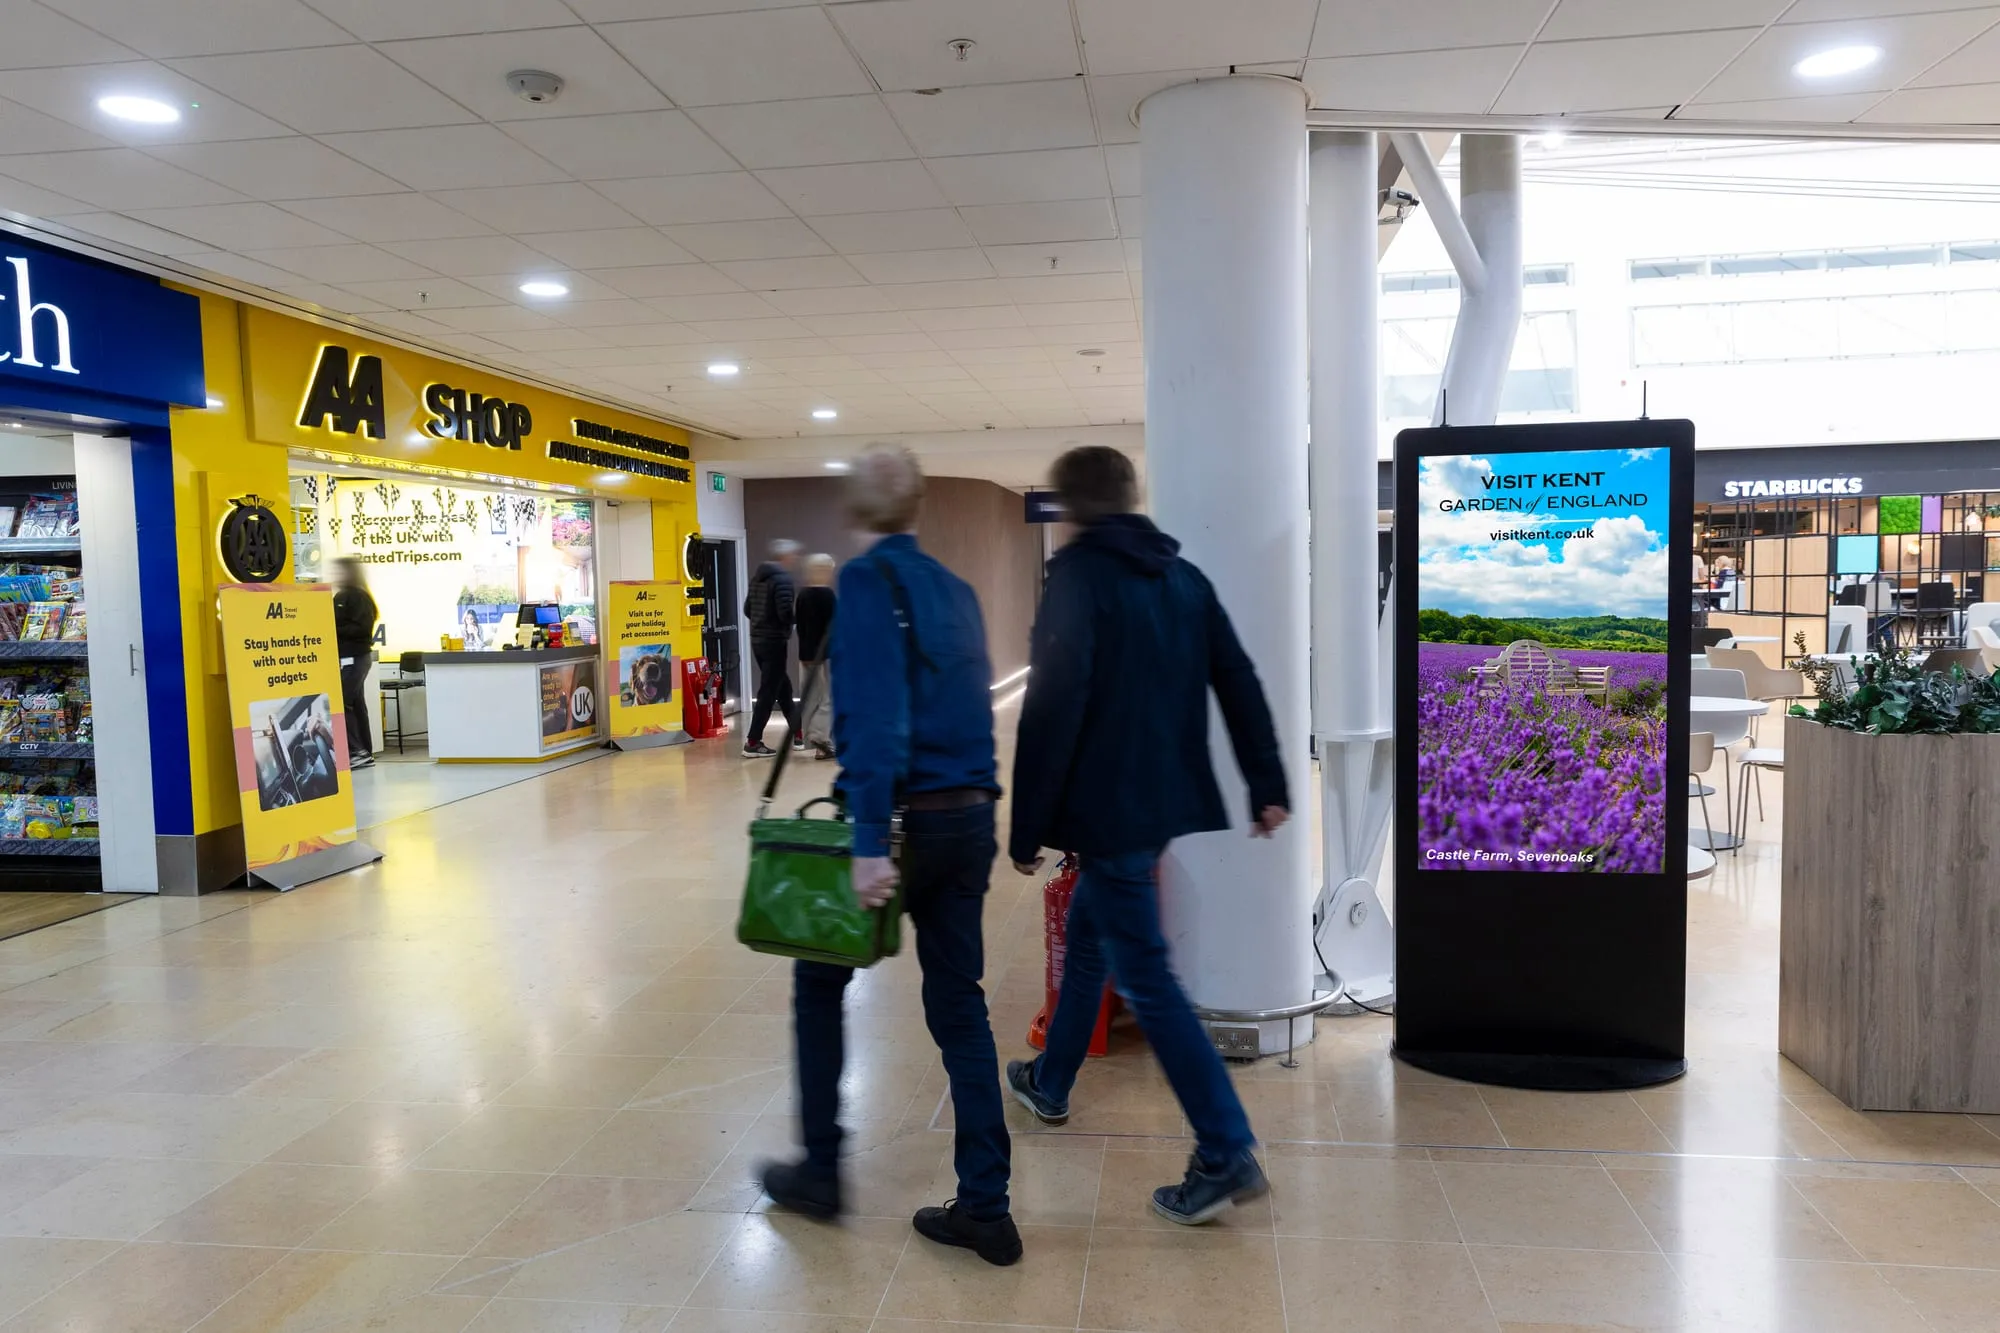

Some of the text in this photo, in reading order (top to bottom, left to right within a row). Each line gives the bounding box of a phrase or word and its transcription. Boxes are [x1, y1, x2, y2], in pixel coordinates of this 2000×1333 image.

[296, 344, 386, 440] AA
[422, 383, 533, 451] SHOP
[52, 481, 77, 490] LIVIN
[1481, 472, 1606, 490] VISIT KENT
[1724, 477, 1863, 497] STARBUCKS
[1439, 493, 1648, 516] GARDEN of ENGLAND
[352, 530, 454, 548] of the UK with
[1490, 527, 1595, 541] visitkent.co.uk
[353, 550, 462, 565] RatedTrips.com
[636, 590, 648, 601] AA
[266, 602, 283, 620] AA
[629, 610, 644, 618] Visit
[654, 610, 664, 618] for
[625, 620, 666, 629] your holiday
[621, 630, 670, 640] pet accessories
[244, 635, 322, 652] Stay hands free
[253, 652, 318, 668] with our tech
[267, 671, 308, 687] gadgets
[574, 692, 591, 716] UK
[1426, 849, 1594, 863] Castle Farm, Sevenoaks
